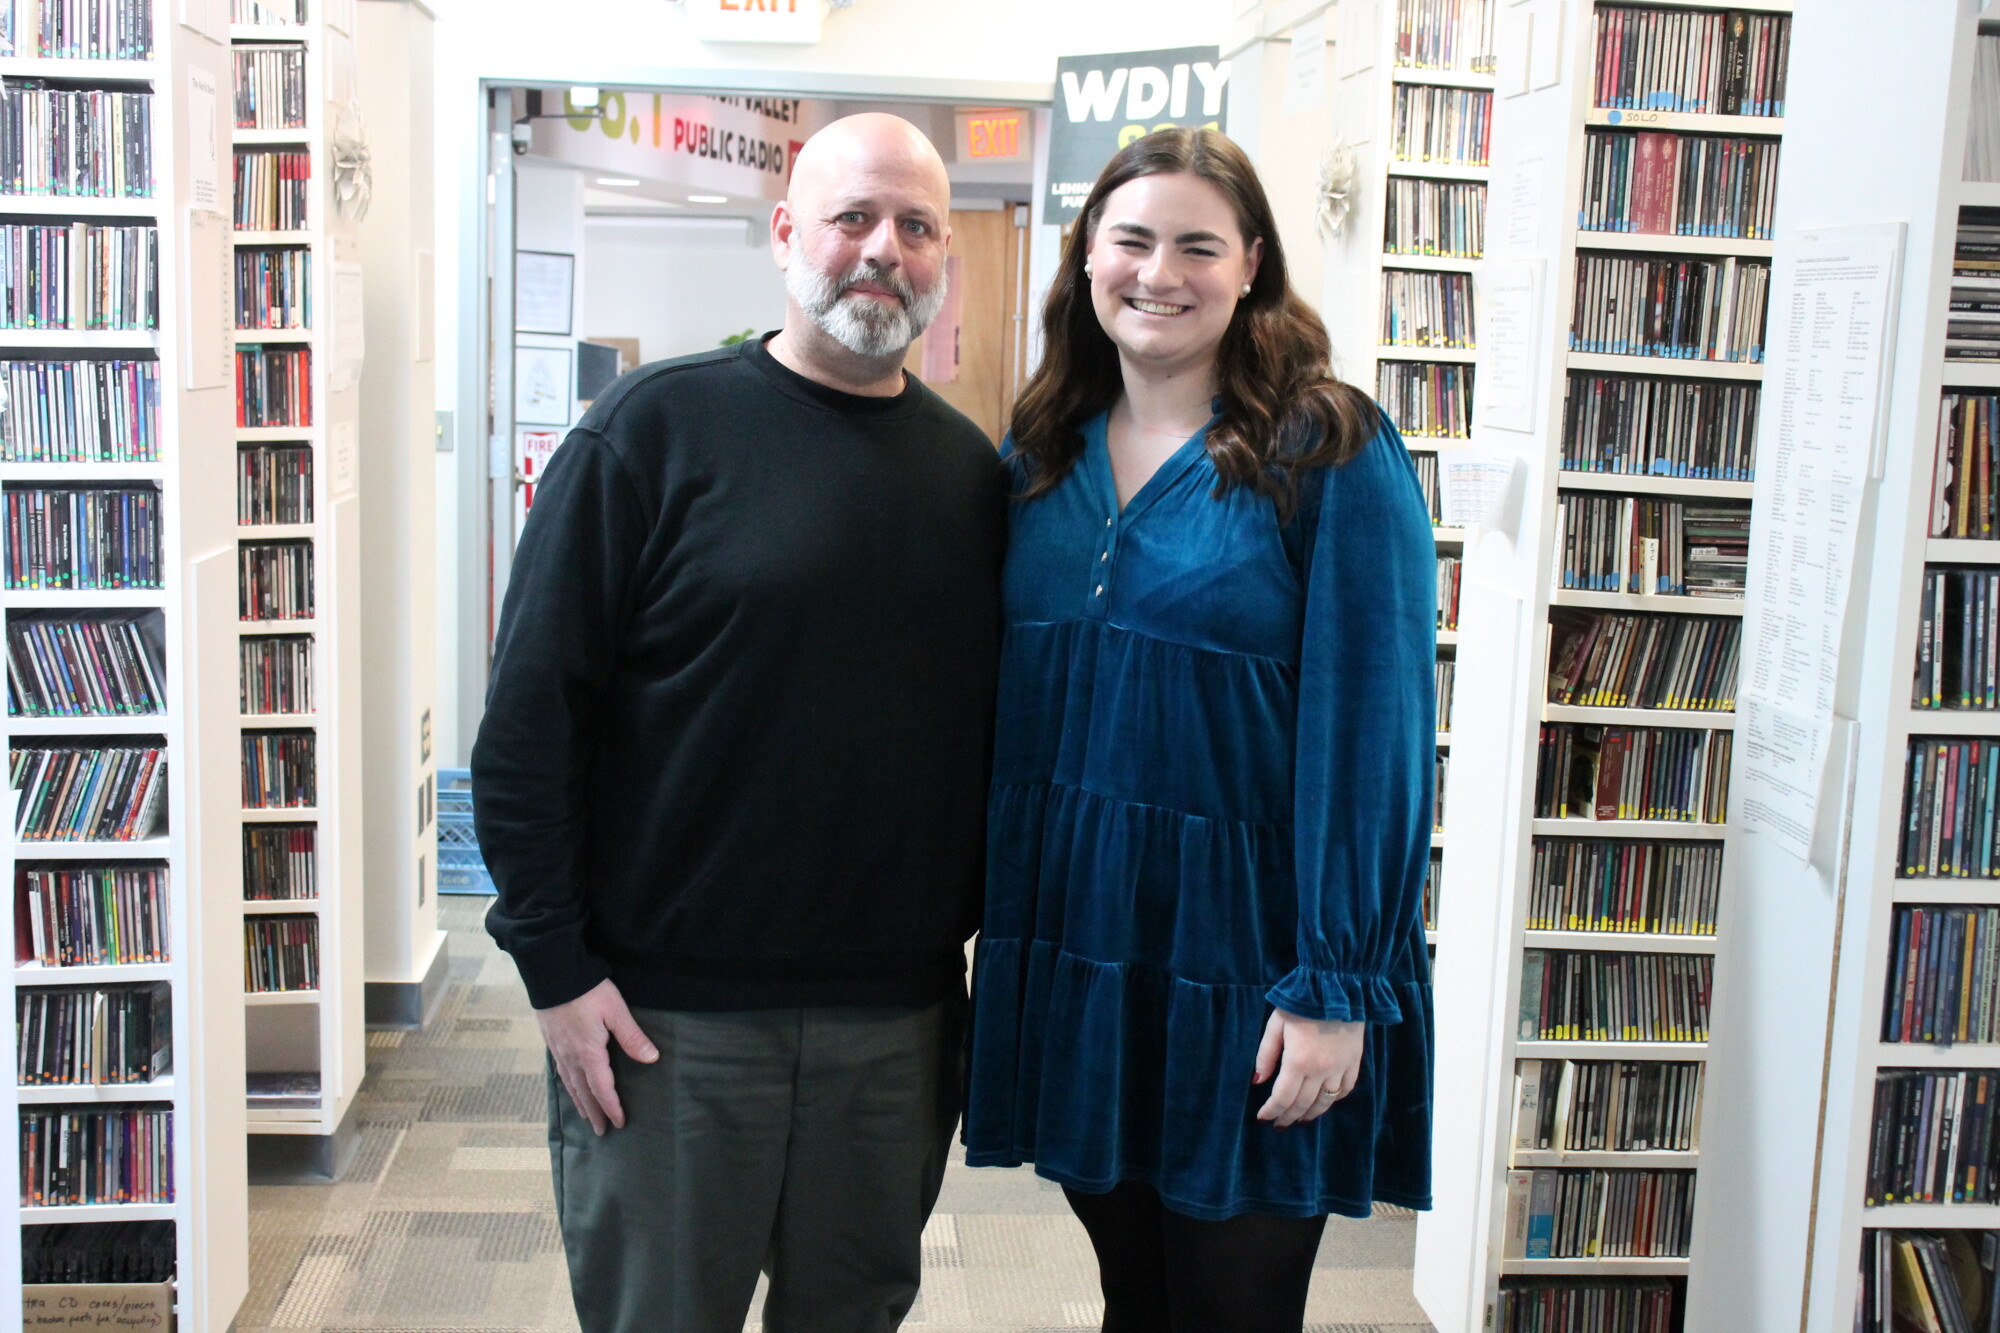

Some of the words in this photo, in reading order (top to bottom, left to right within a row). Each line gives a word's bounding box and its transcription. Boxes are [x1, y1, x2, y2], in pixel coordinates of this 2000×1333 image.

[1061, 60, 1232, 122] WDIY
[1626, 112, 1658, 123] SOLO
[674, 117, 733, 163] PUBLIC
[738, 134, 783, 174] RADIO
[968, 116, 1020, 157] EXIT
[528, 440, 554, 452] FIRE
[59, 1296, 79, 1308] CD
